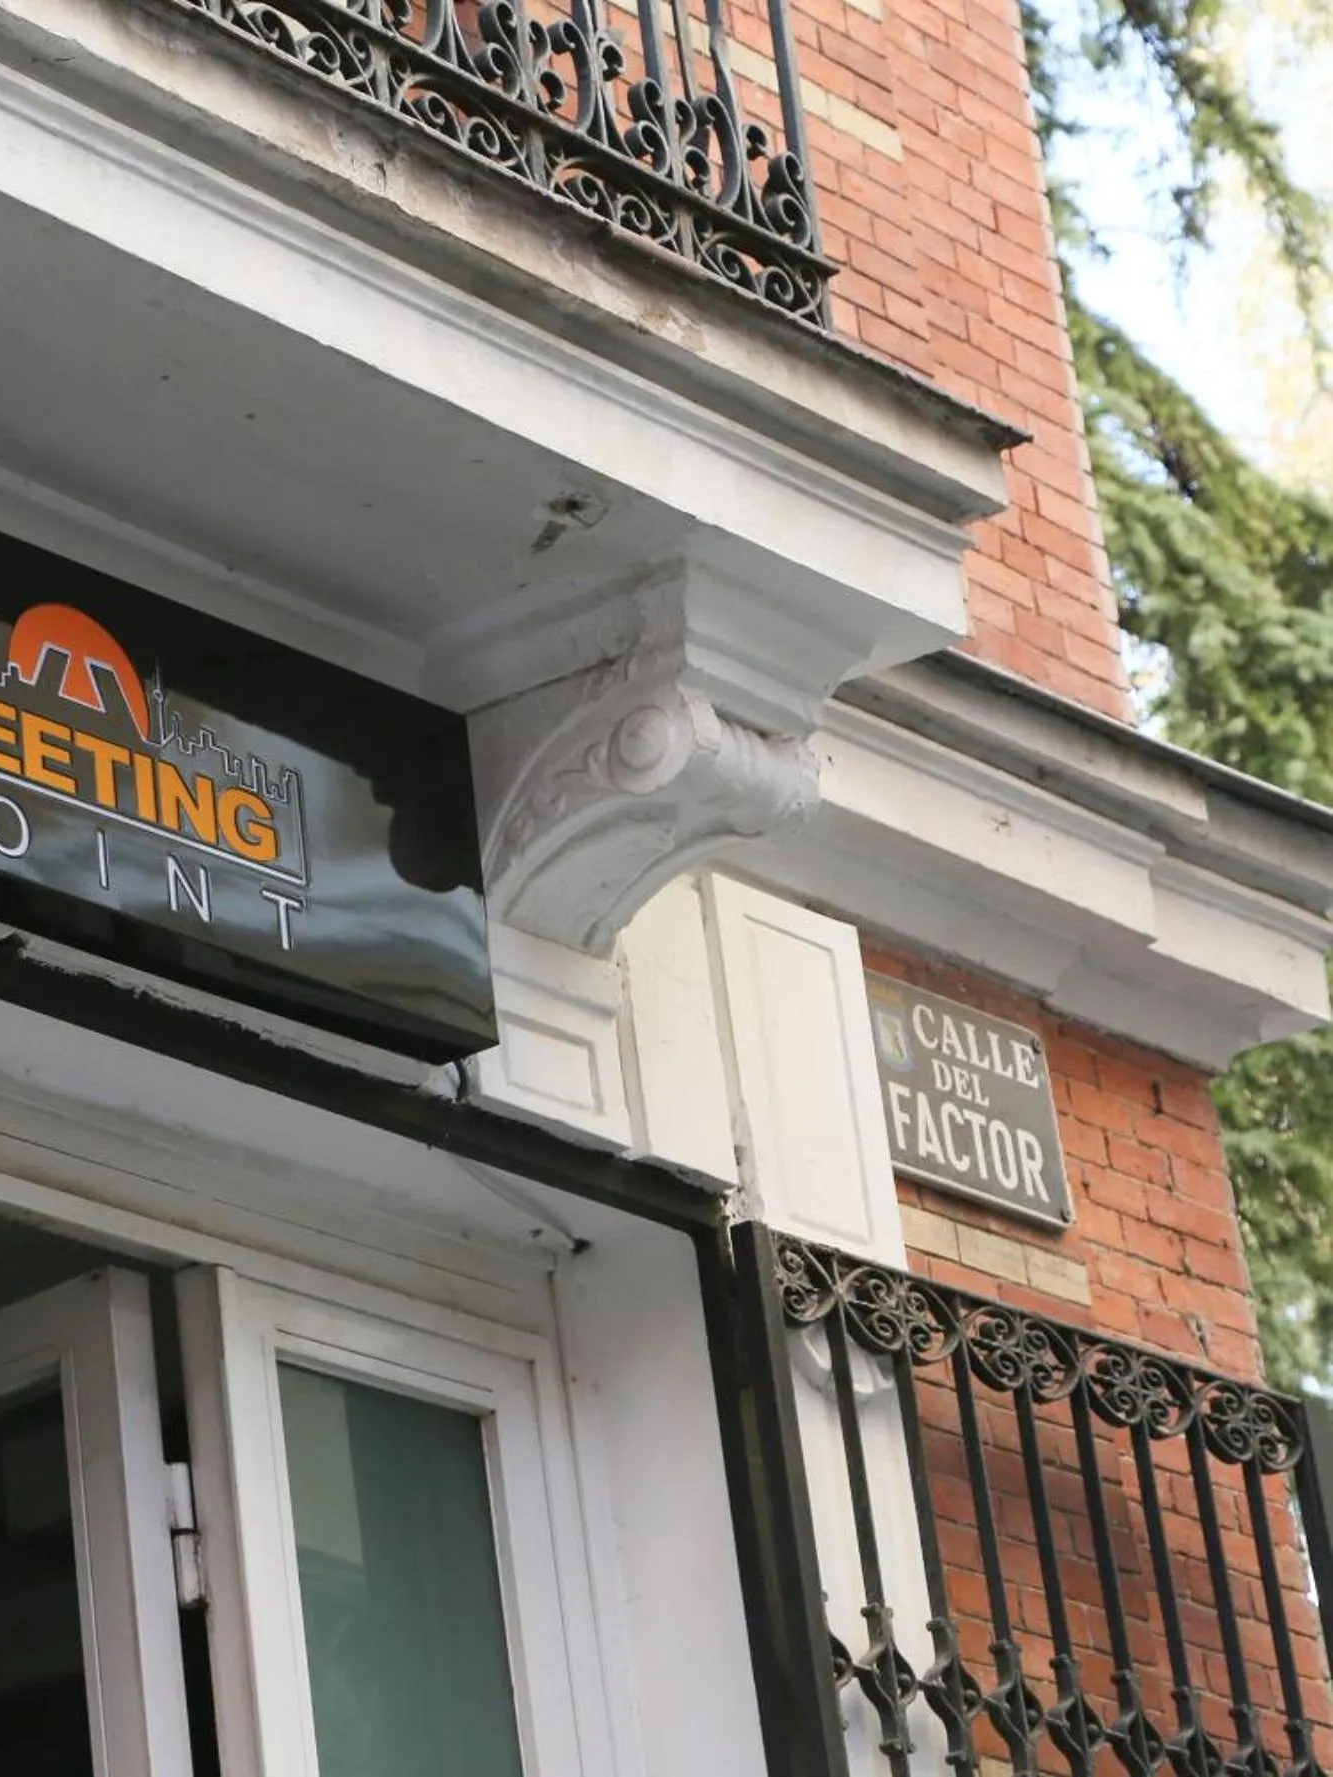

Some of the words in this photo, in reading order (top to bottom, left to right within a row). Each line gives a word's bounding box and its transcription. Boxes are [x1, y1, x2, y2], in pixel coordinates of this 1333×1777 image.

[912, 1003, 1040, 1089] CALLE
[931, 1058, 990, 1108] DEL
[887, 1080, 1050, 1204] FACTOR
